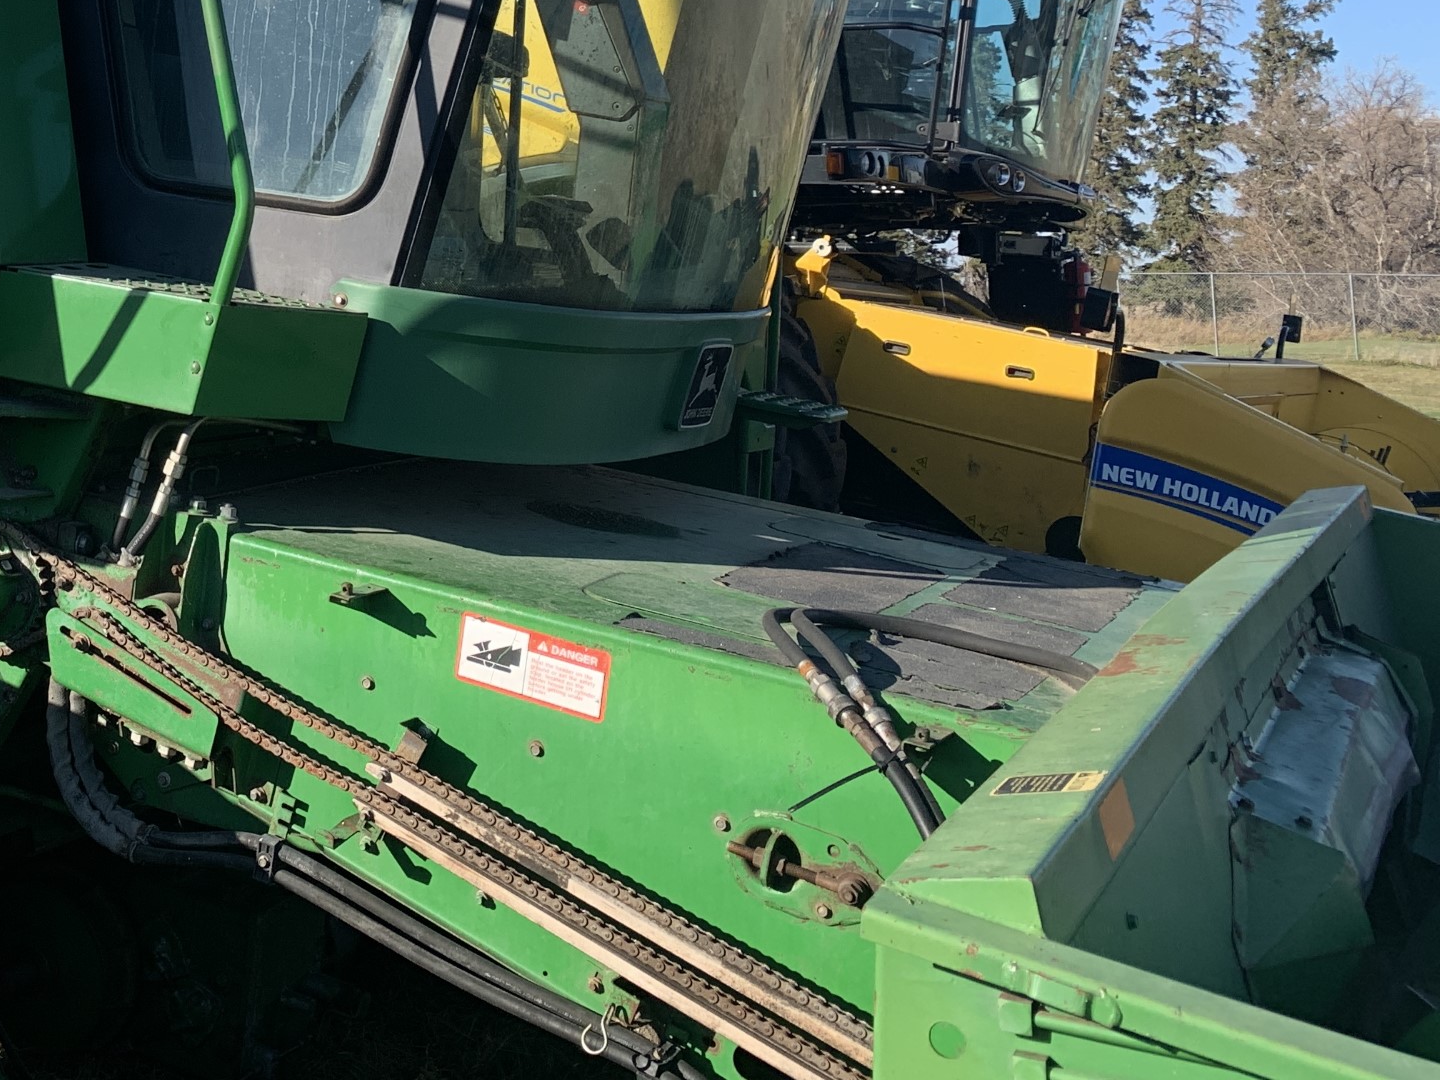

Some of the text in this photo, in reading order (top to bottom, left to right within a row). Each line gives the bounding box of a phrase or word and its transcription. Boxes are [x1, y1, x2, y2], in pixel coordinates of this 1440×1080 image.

[1101, 462, 1277, 527] NEW HOLLAND
[550, 644, 599, 668] DANGER
